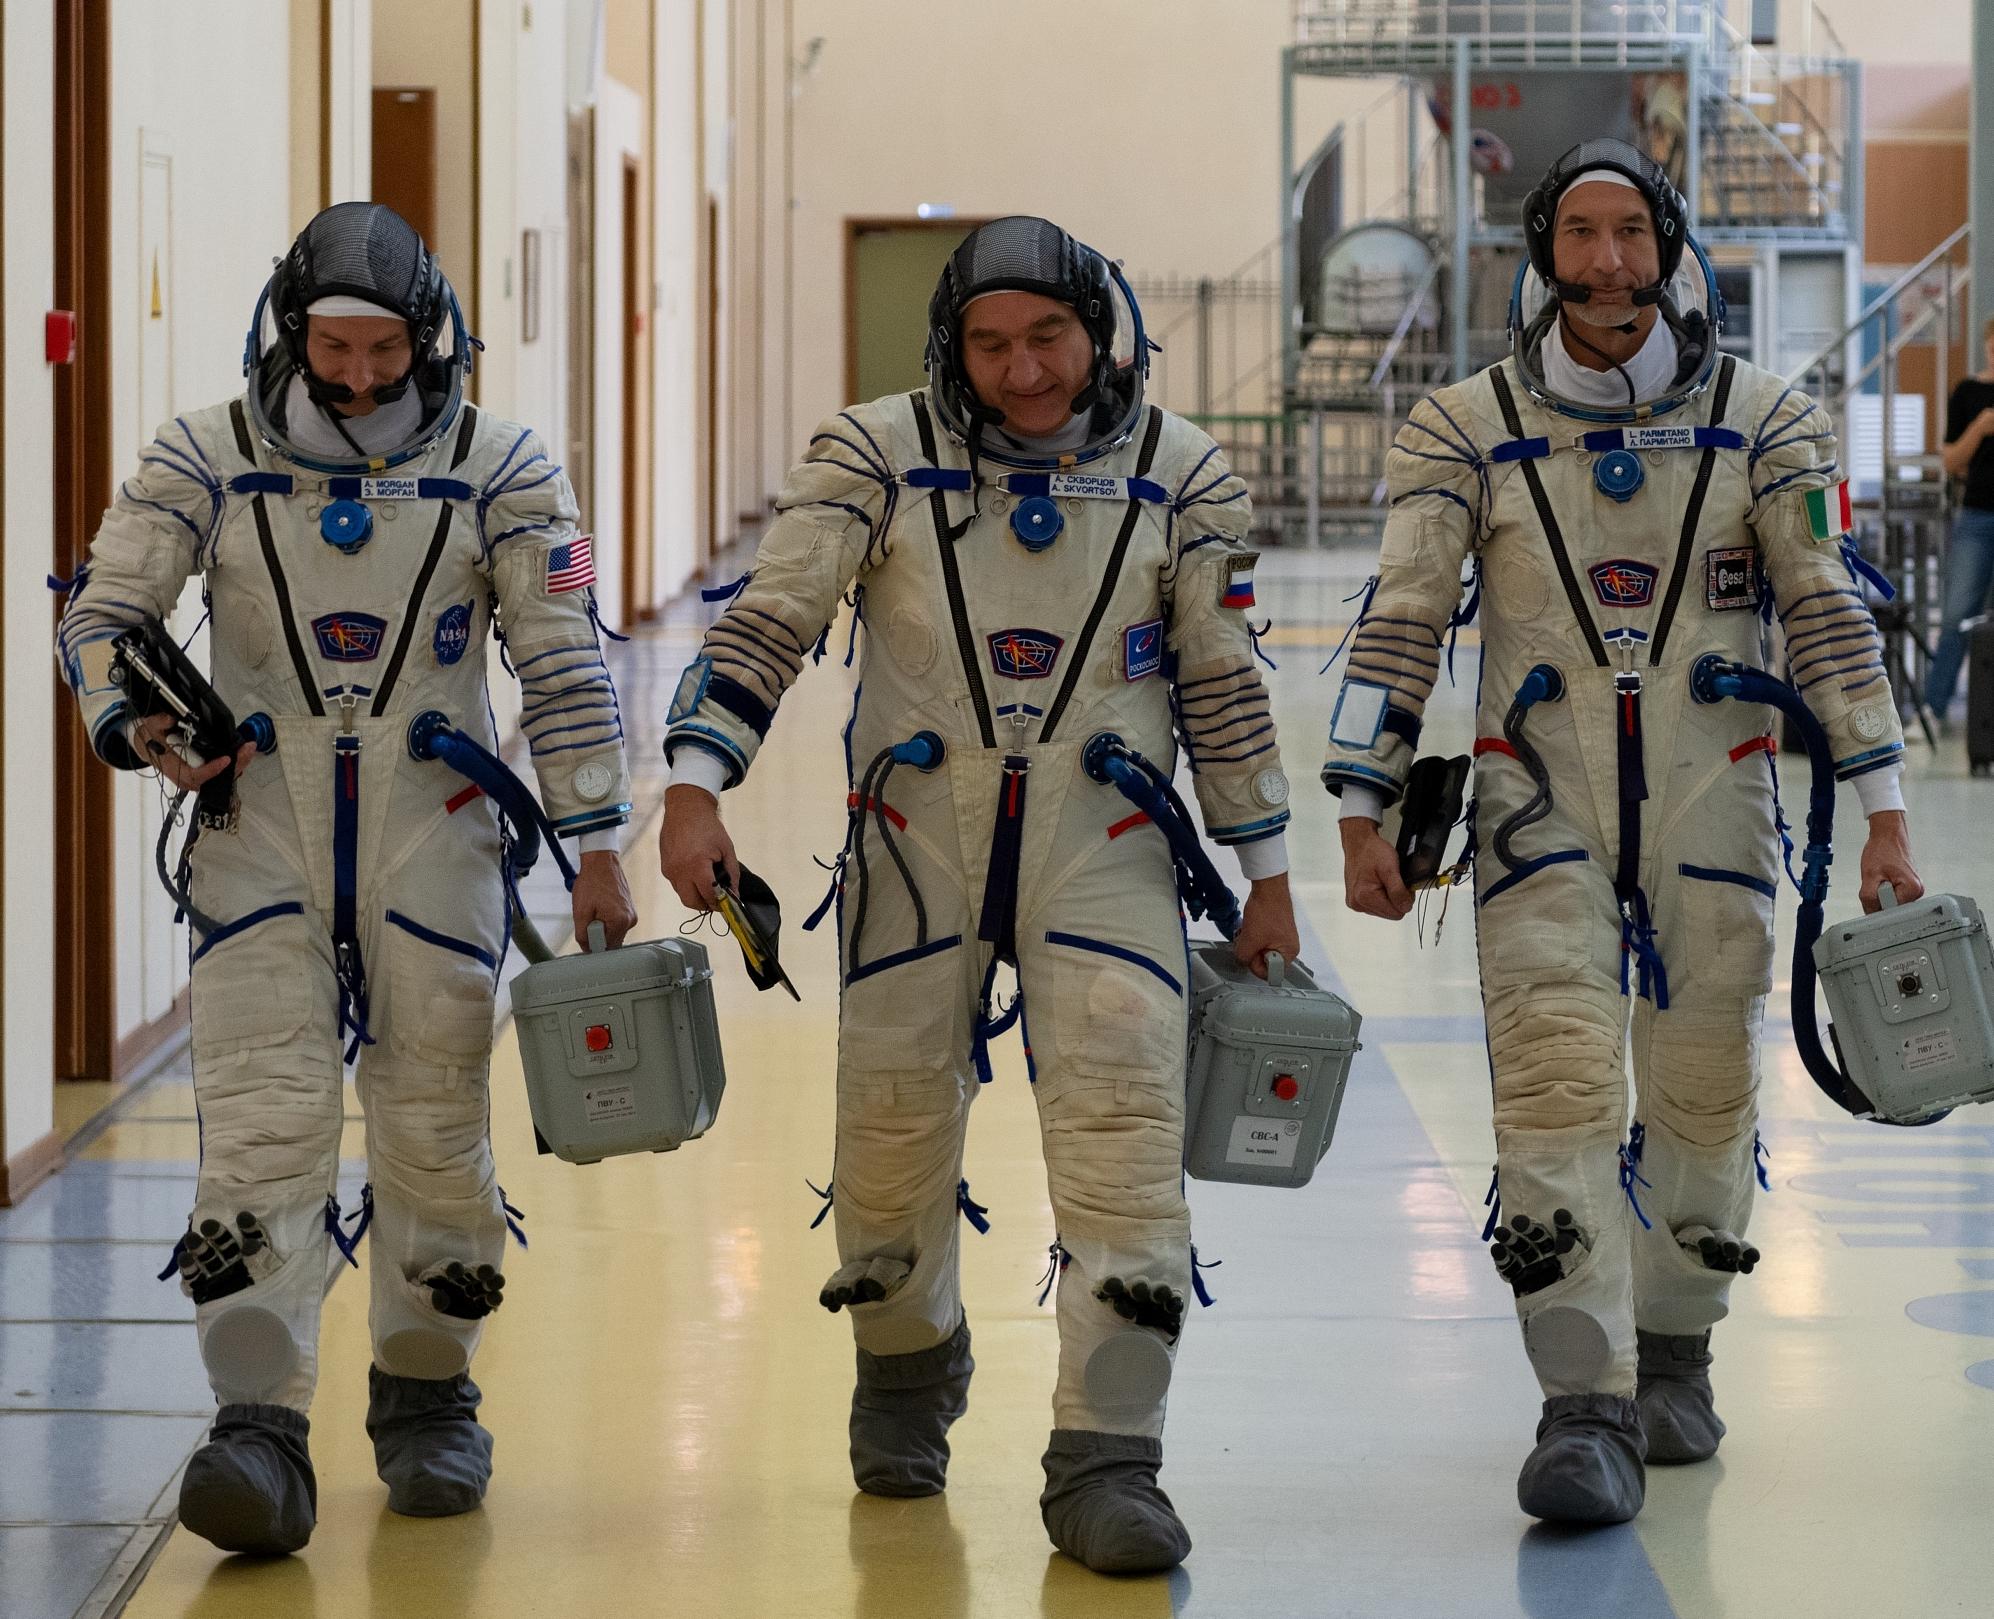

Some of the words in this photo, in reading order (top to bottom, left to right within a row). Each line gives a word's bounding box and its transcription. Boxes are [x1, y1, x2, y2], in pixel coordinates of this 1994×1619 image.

[1629, 430, 1637, 438] L.
[1640, 429, 1690, 438] PARMITANO
[1640, 437, 1690, 446] ПАРМИТАНО
[364, 480, 373, 488] A.
[376, 480, 415, 488] MORGAN
[1067, 475, 1115, 487] СКВОРЦОВ
[365, 489, 373, 497] Э.
[377, 489, 415, 497] МОРГАН
[1052, 483, 1060, 491] A.
[1064, 484, 1118, 496] SKVORTSOV
[440, 628, 467, 642] NASA
[1129, 656, 1159, 673] РОСКОСМОС
